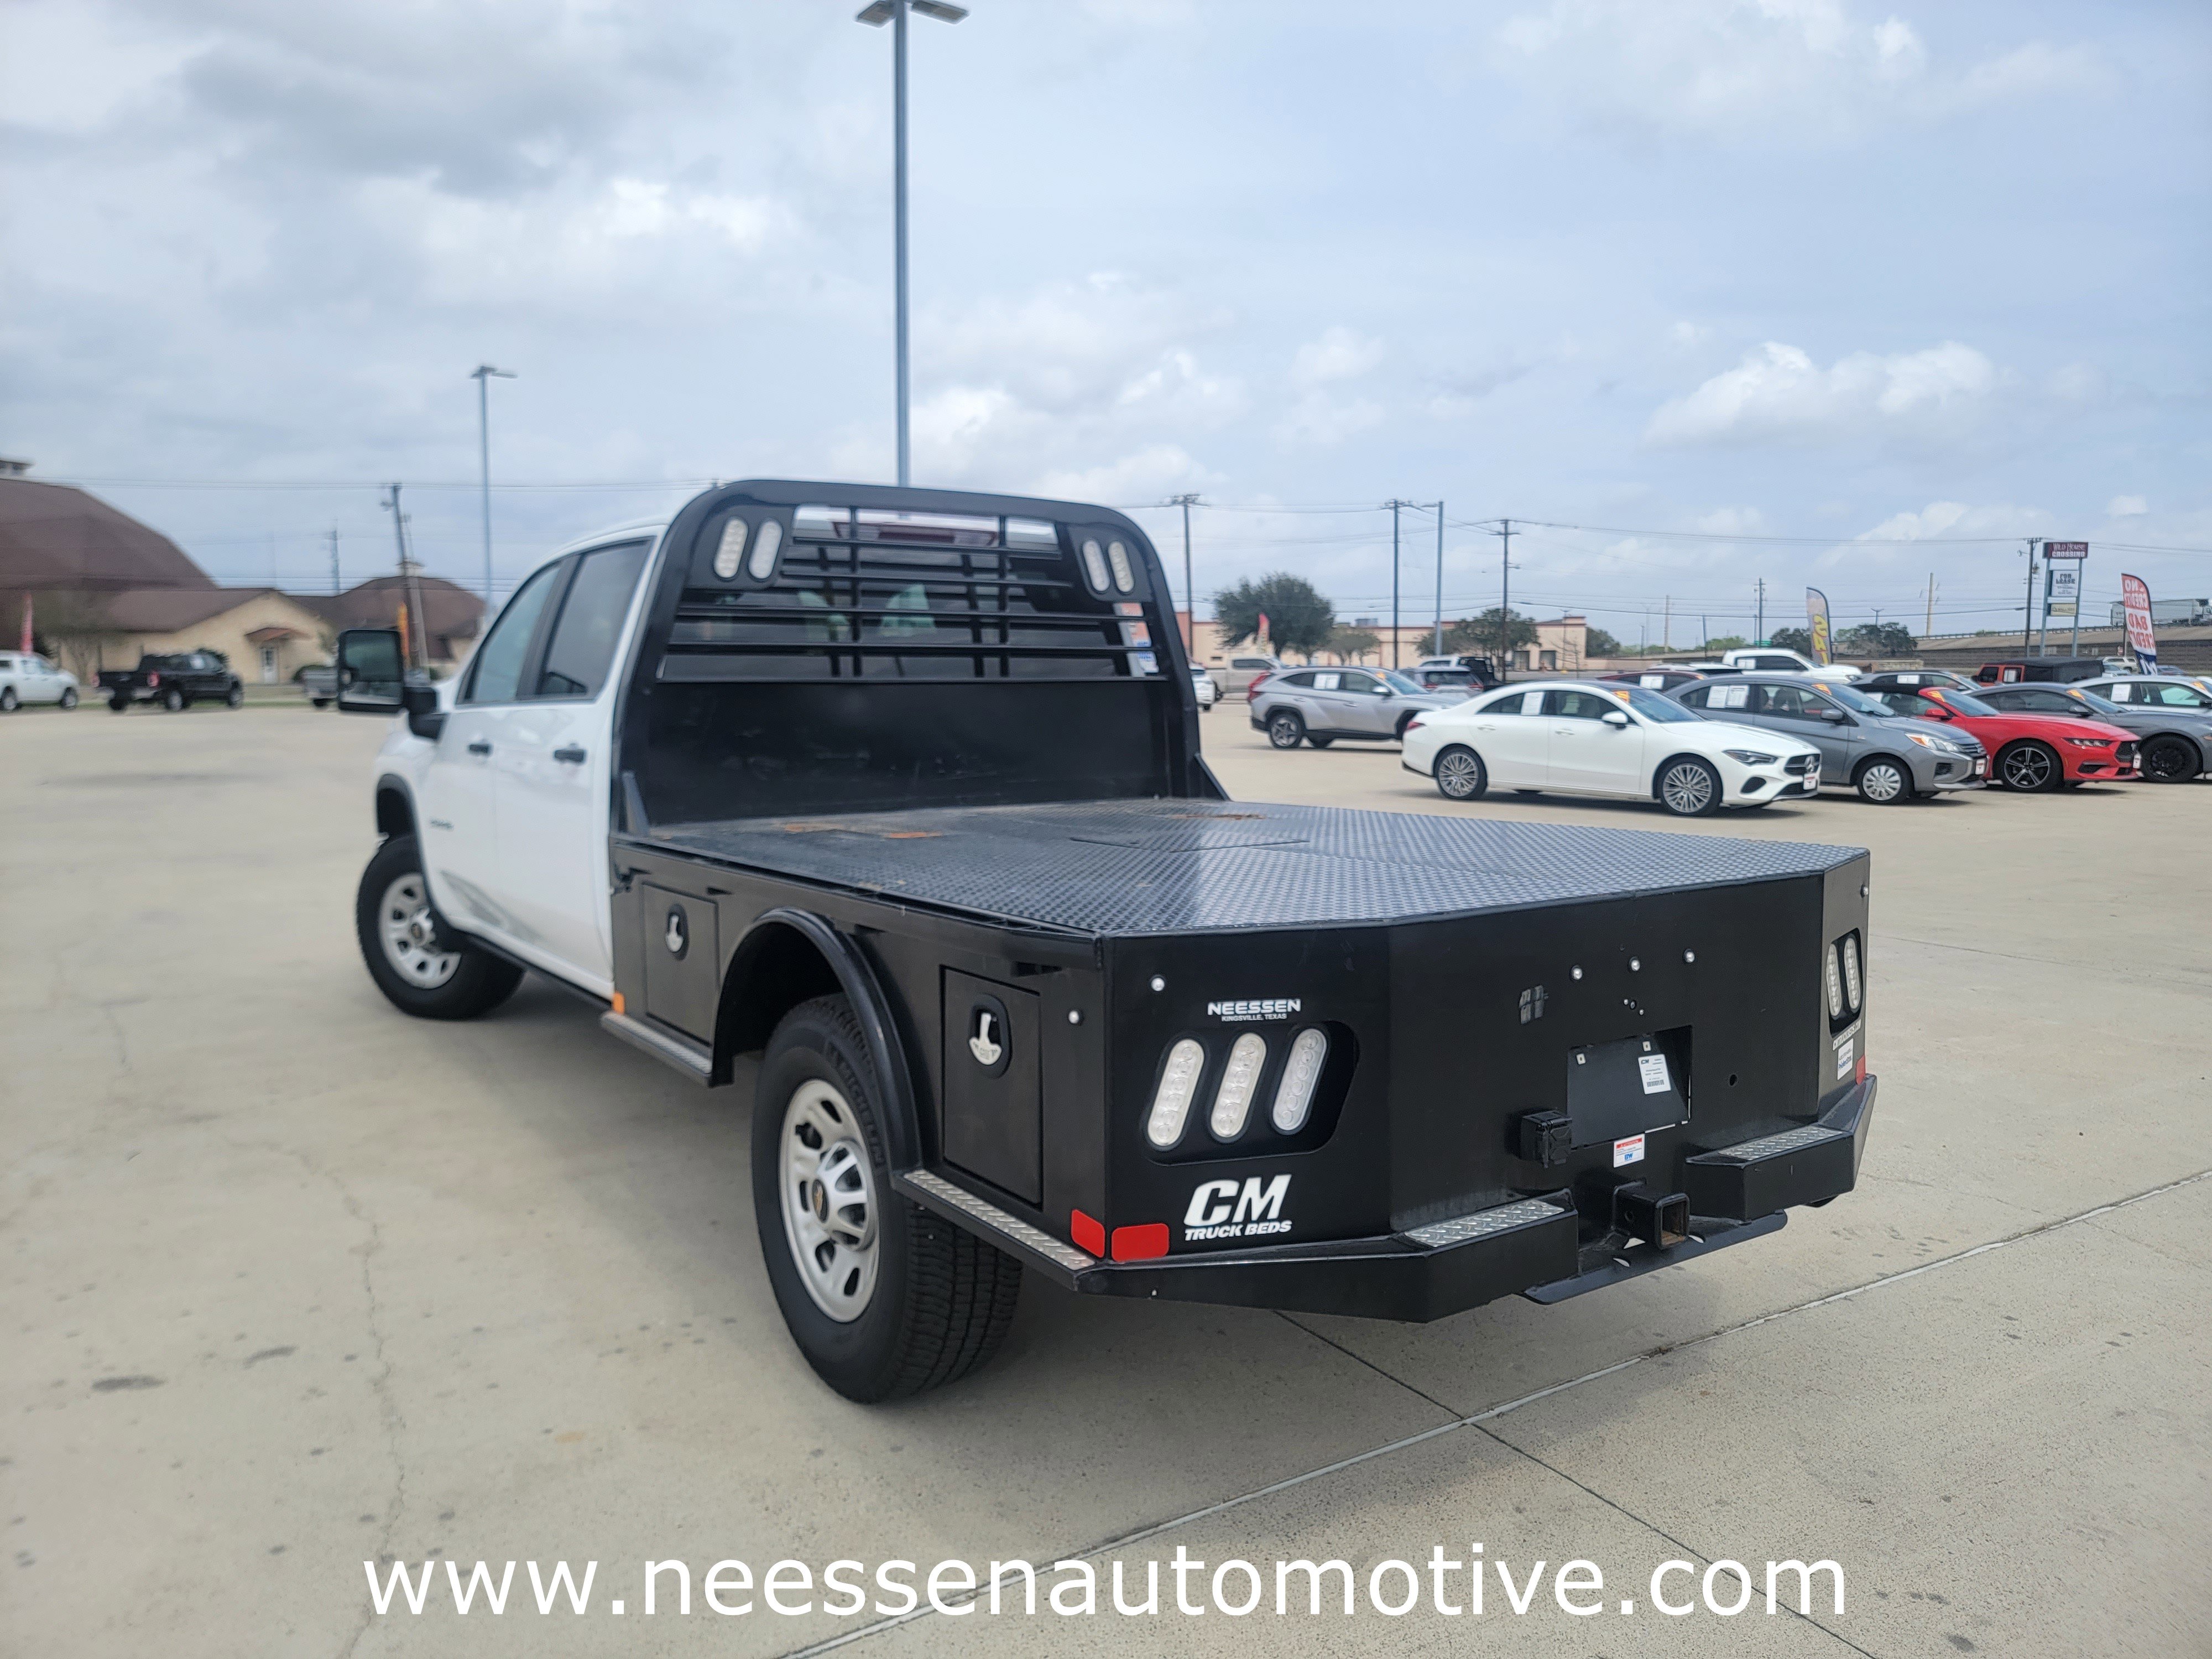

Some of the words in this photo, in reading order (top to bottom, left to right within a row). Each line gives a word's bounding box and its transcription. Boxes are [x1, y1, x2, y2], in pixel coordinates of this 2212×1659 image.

[1208, 998, 1301, 1015] NEESSEN
[1183, 1174, 1292, 1227] CM
[1185, 1224, 1243, 1241] TRUCK
[1245, 1219, 1292, 1235] BEDS
